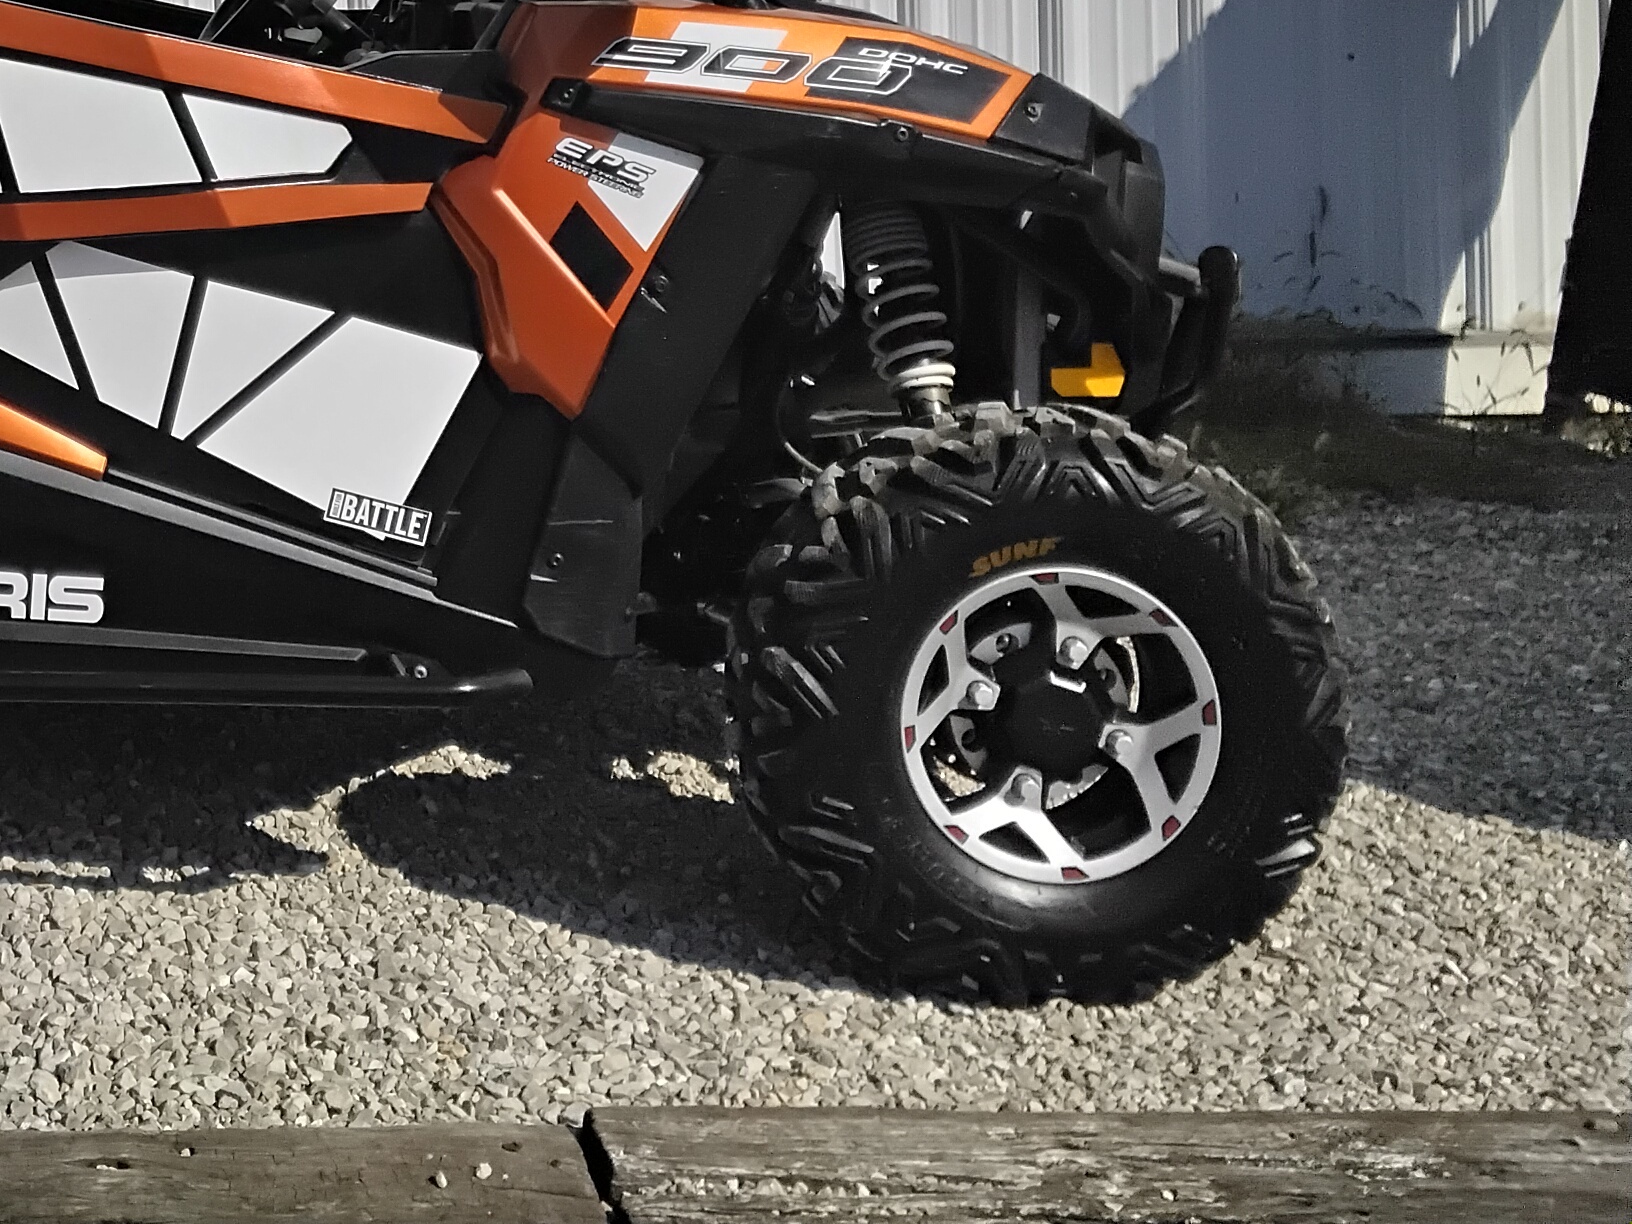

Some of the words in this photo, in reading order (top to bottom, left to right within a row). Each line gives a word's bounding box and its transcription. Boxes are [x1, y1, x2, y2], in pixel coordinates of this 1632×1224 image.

[591, 36, 913, 96] 900
[857, 46, 970, 76] DOHC
[547, 156, 589, 178] POWER
[555, 136, 657, 183] EPS
[340, 493, 426, 540] BATTLE
